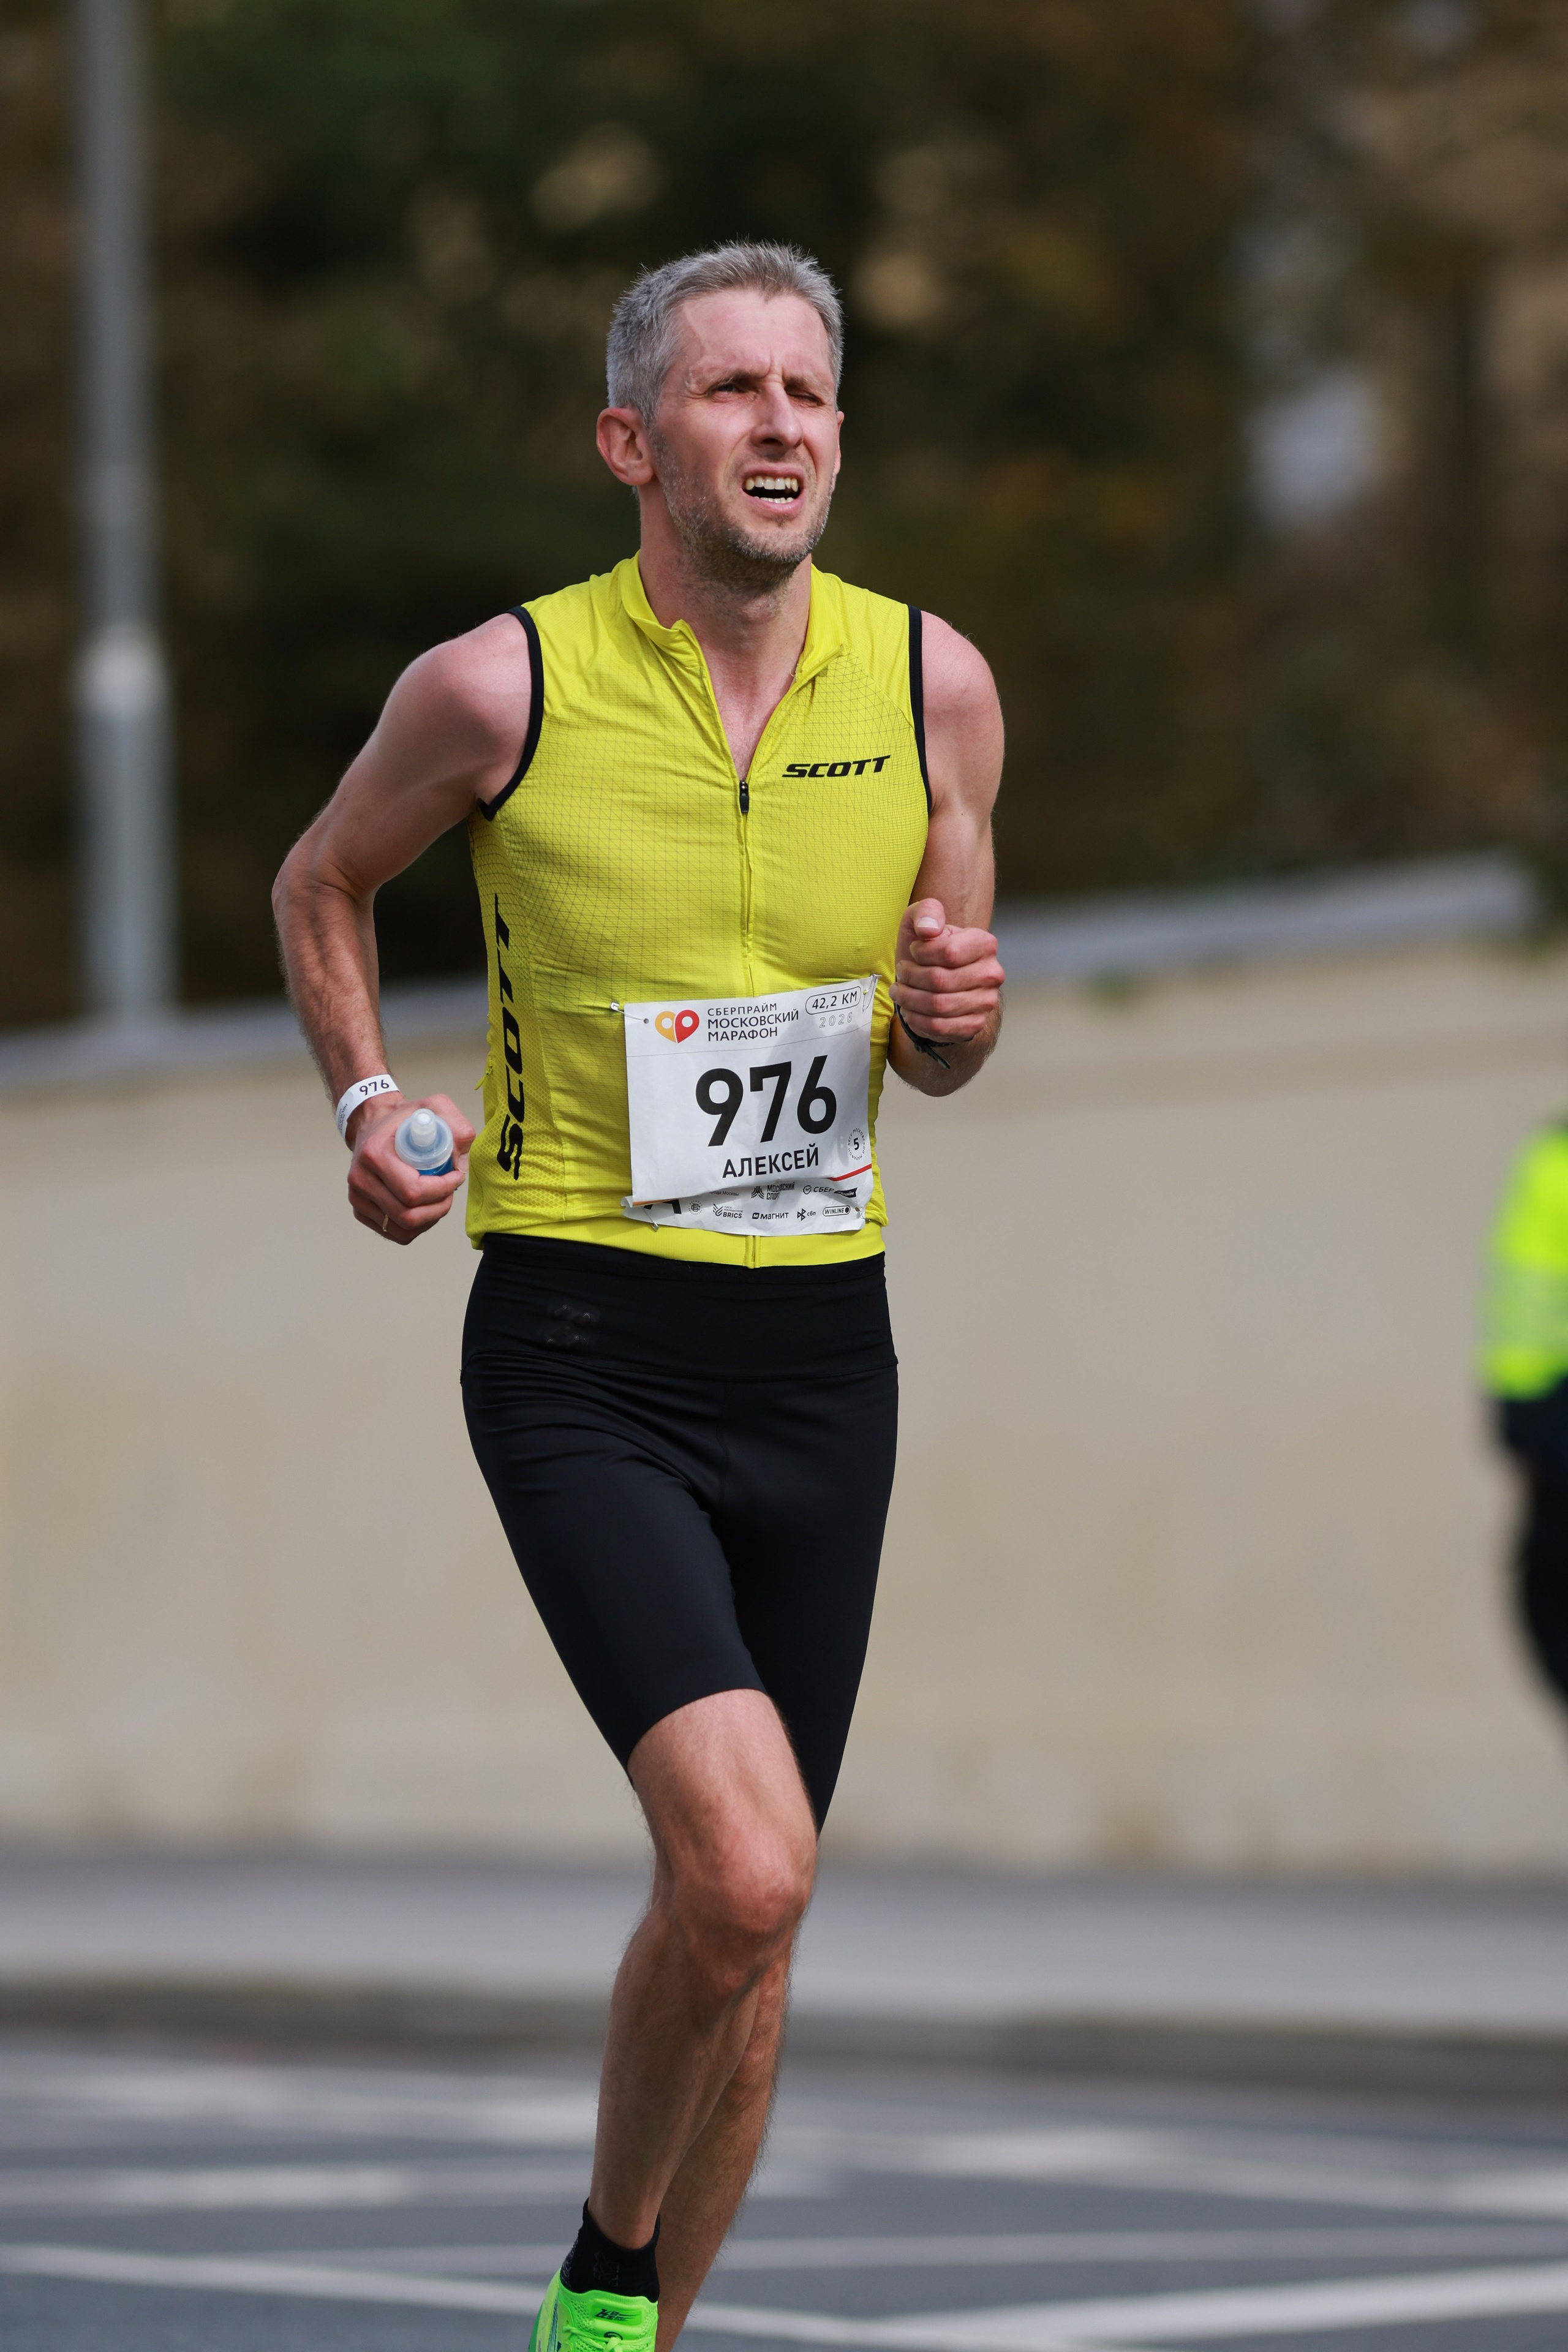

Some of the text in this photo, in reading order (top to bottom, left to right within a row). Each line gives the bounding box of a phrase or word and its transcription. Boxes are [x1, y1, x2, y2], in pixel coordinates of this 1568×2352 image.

[782, 755, 891, 778] SCOTT
[707, 1003, 777, 1016] СБЕРПРАЙМ
[812, 990, 858, 1009] 42,2 КМ
[707, 1008, 799, 1029] МОСКОВСКИЙ
[495, 893, 525, 1181] SCOTT
[708, 1027, 778, 1042] МАРАФОН
[359, 1079, 390, 1095] 976
[695, 1055, 837, 1147] 976
[853, 1137, 860, 1151] 5
[722, 1143, 819, 1178] АЛЕКСЕЙ
